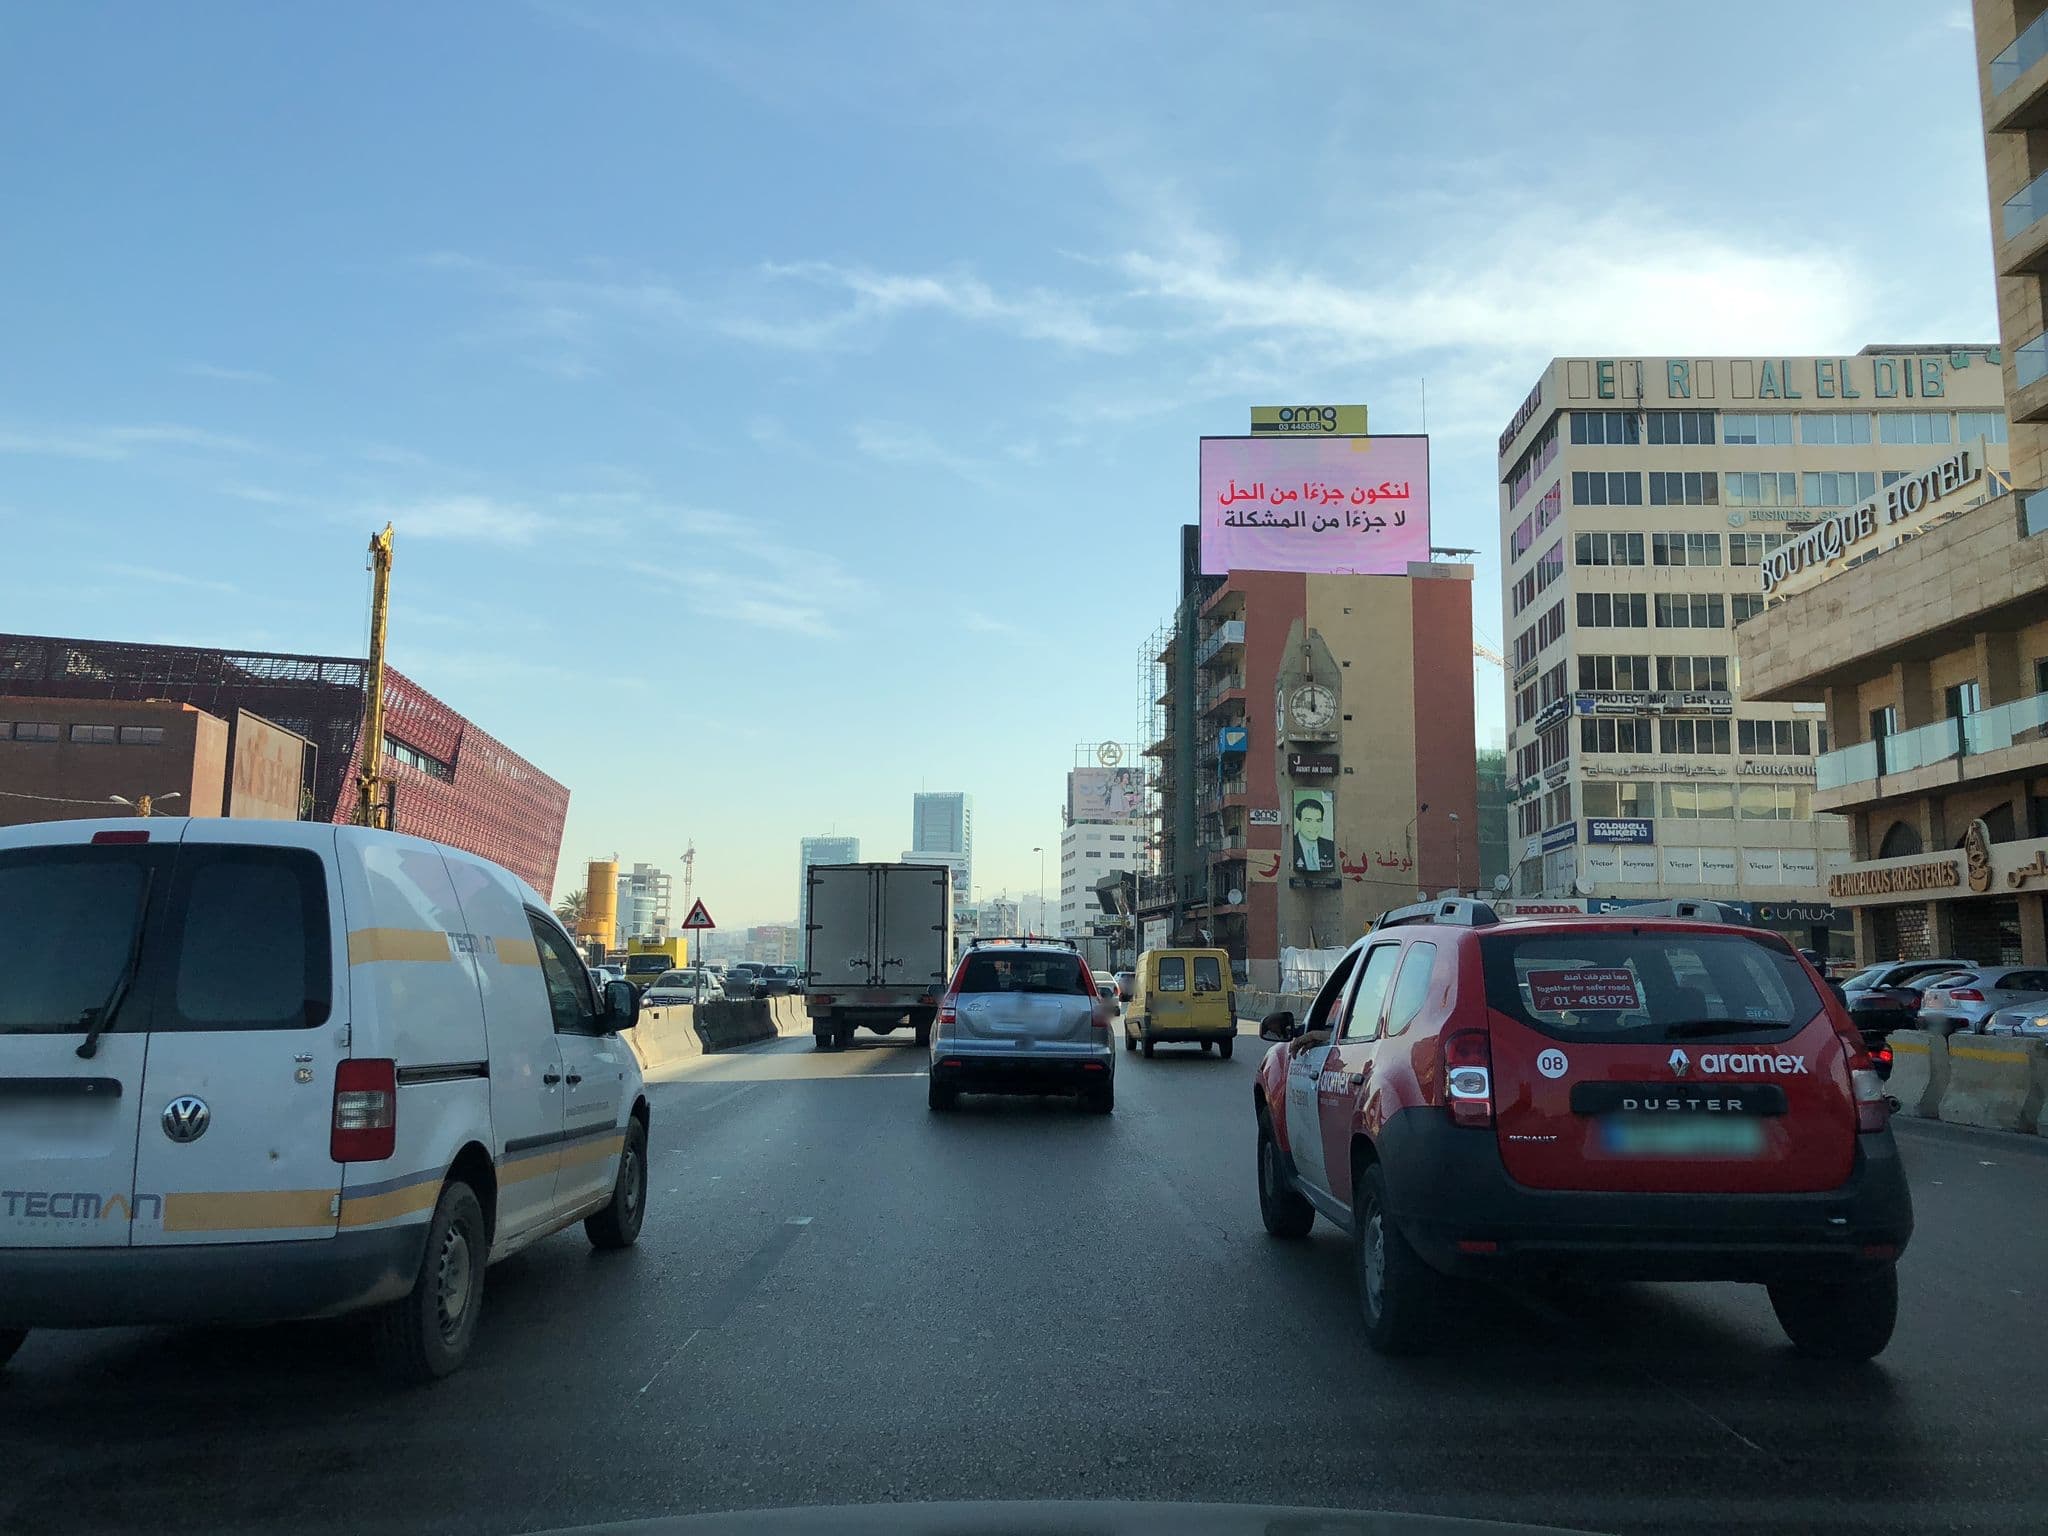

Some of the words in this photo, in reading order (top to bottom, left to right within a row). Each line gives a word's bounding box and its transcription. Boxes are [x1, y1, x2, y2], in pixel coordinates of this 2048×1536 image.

[1816, 359, 1861, 399] EL
[1873, 357, 1945, 398] DIB
[1278, 407, 1337, 432] omg
[1270, 486, 1298, 505] من
[1350, 482, 1410, 505] لنكون
[1224, 510, 1306, 528] المشكلة
[1311, 515, 1340, 533] من
[1393, 510, 1406, 526] لا
[1749, 511, 1811, 521] BUSINESS
[1760, 503, 1878, 594] BOUTIQUE
[1887, 451, 1982, 526] HOTEL
[1595, 692, 1645, 704] PROTECT
[1648, 692, 1666, 704] Mid
[1683, 692, 1707, 705] East
[1669, 860, 1693, 868] Victor
[1749, 862, 1773, 870] Victor
[1828, 874, 1841, 898] AL
[1841, 868, 1891, 896] ANDALOUS
[1892, 860, 1959, 892] ROASTERIES
[1516, 904, 1584, 915] HONDA
[1541, 1056, 1564, 1071] 08
[1700, 1053, 1809, 1074] aramex
[1319, 1071, 1351, 1095] aramex
[1623, 1099, 1743, 1111] DUSTER
